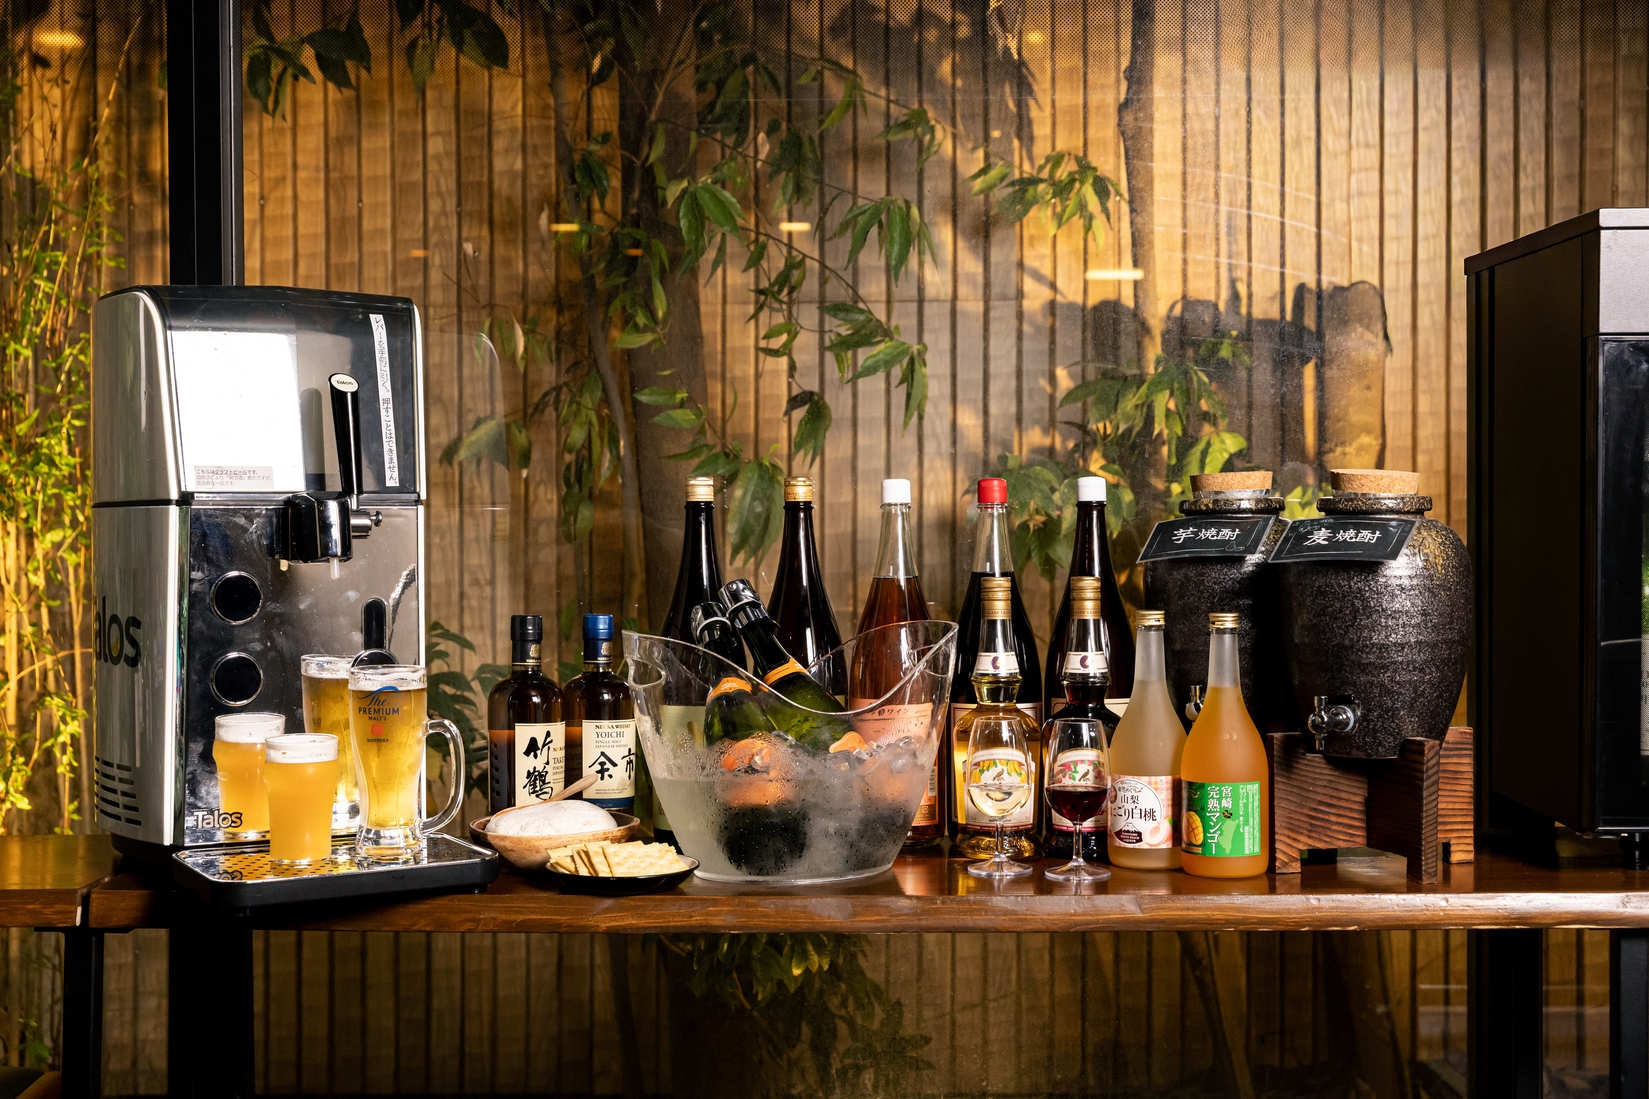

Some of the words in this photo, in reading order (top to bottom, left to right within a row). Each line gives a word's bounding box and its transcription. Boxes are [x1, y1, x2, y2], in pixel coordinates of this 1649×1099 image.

[1171, 527, 1240, 544] 芋焼酎
[1303, 527, 1381, 546] 麦焼酎
[358, 706, 400, 715] PREMIUM
[595, 730, 625, 738] YOICHI
[522, 729, 554, 801] 竹鶴
[588, 748, 636, 781] 余市
[1120, 794, 1140, 804] 山梨
[1221, 785, 1233, 809] 宮崎
[193, 808, 243, 829] Talos
[1206, 786, 1222, 855] 完熟マンゴー
